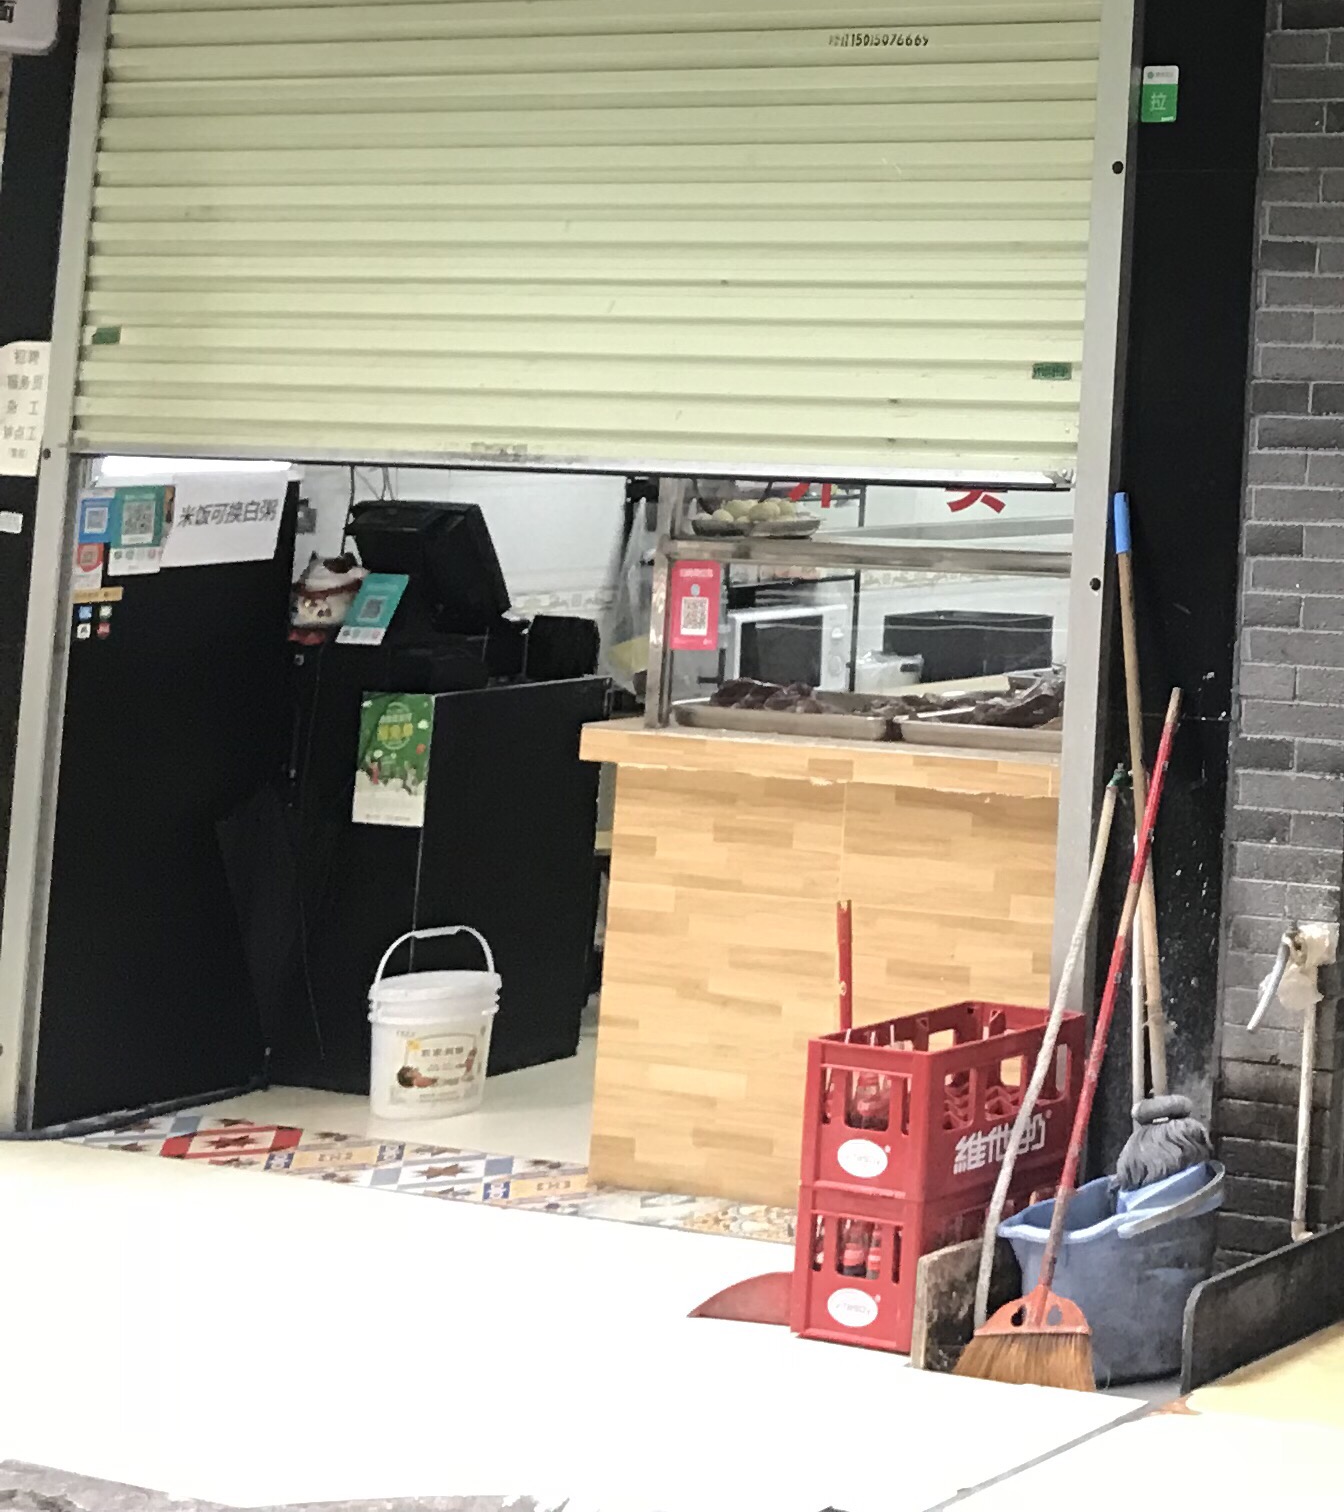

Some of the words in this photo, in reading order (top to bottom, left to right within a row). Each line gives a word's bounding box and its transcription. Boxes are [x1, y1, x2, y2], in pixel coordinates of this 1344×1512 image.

[178, 498, 279, 528] 米饭可换白粥
